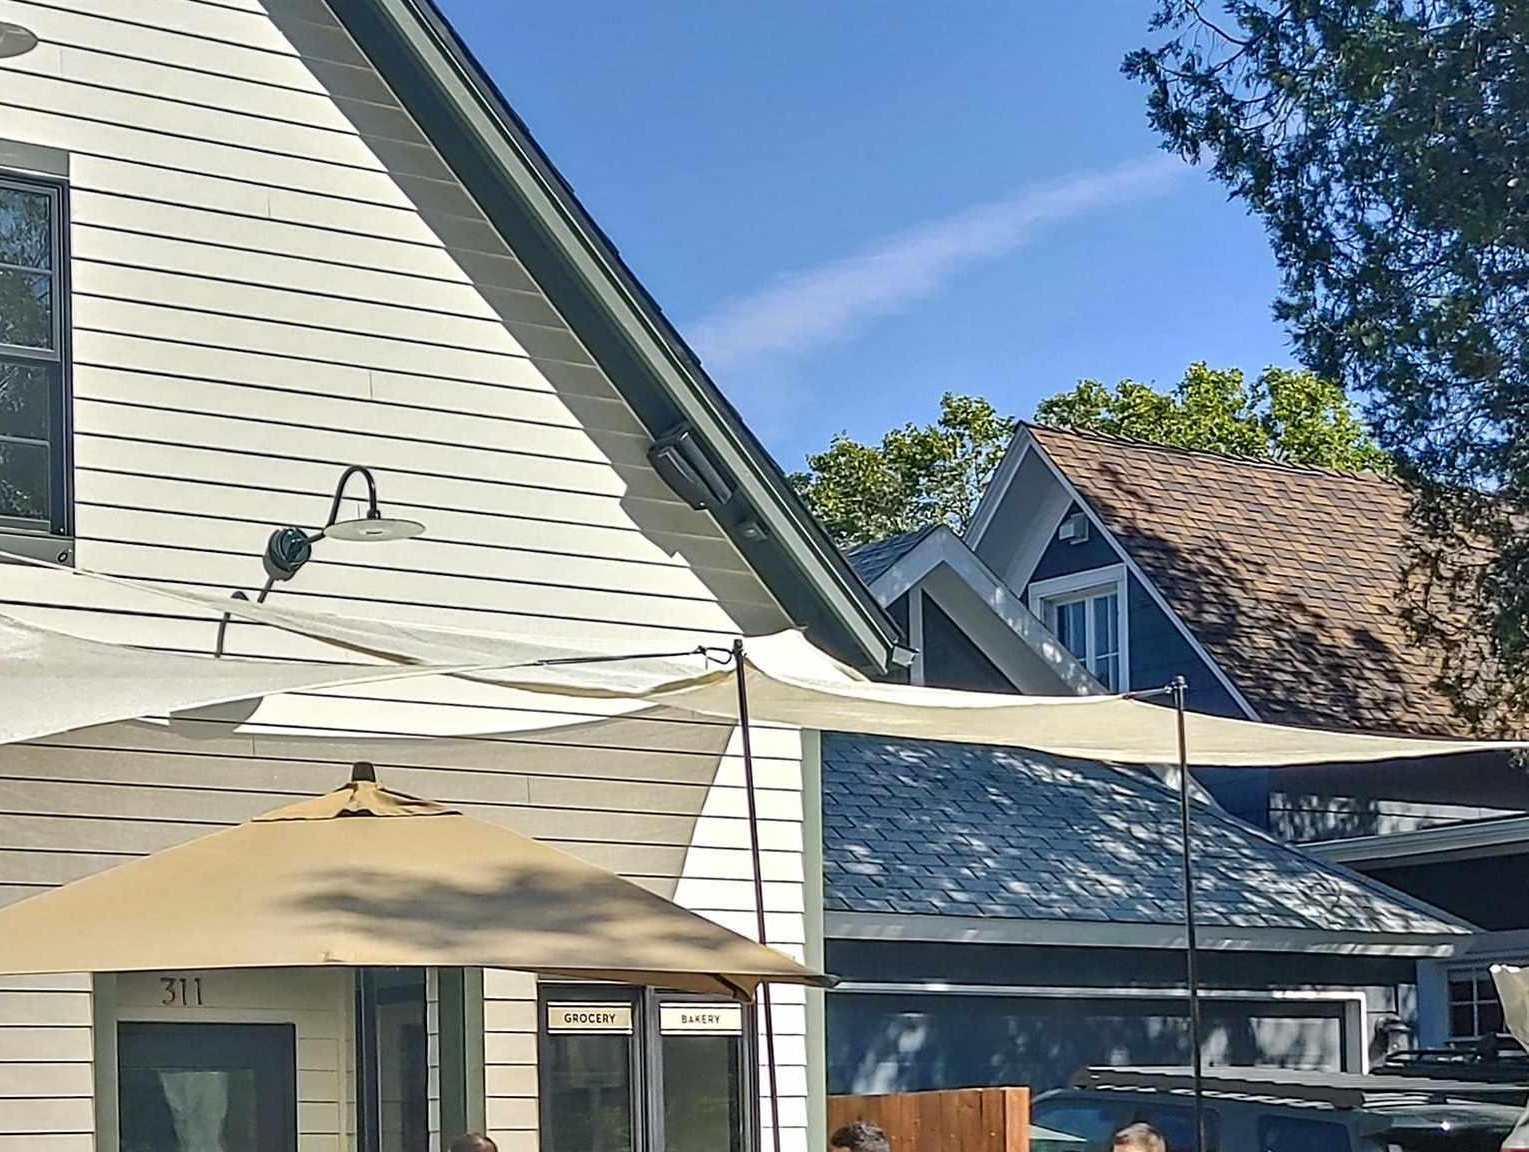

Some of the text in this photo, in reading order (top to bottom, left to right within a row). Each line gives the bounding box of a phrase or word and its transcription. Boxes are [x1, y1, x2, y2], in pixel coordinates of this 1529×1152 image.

[160, 977, 202, 1005] 311
[564, 1012, 616, 1024] GROCERY
[681, 1015, 720, 1025] BAKERY
